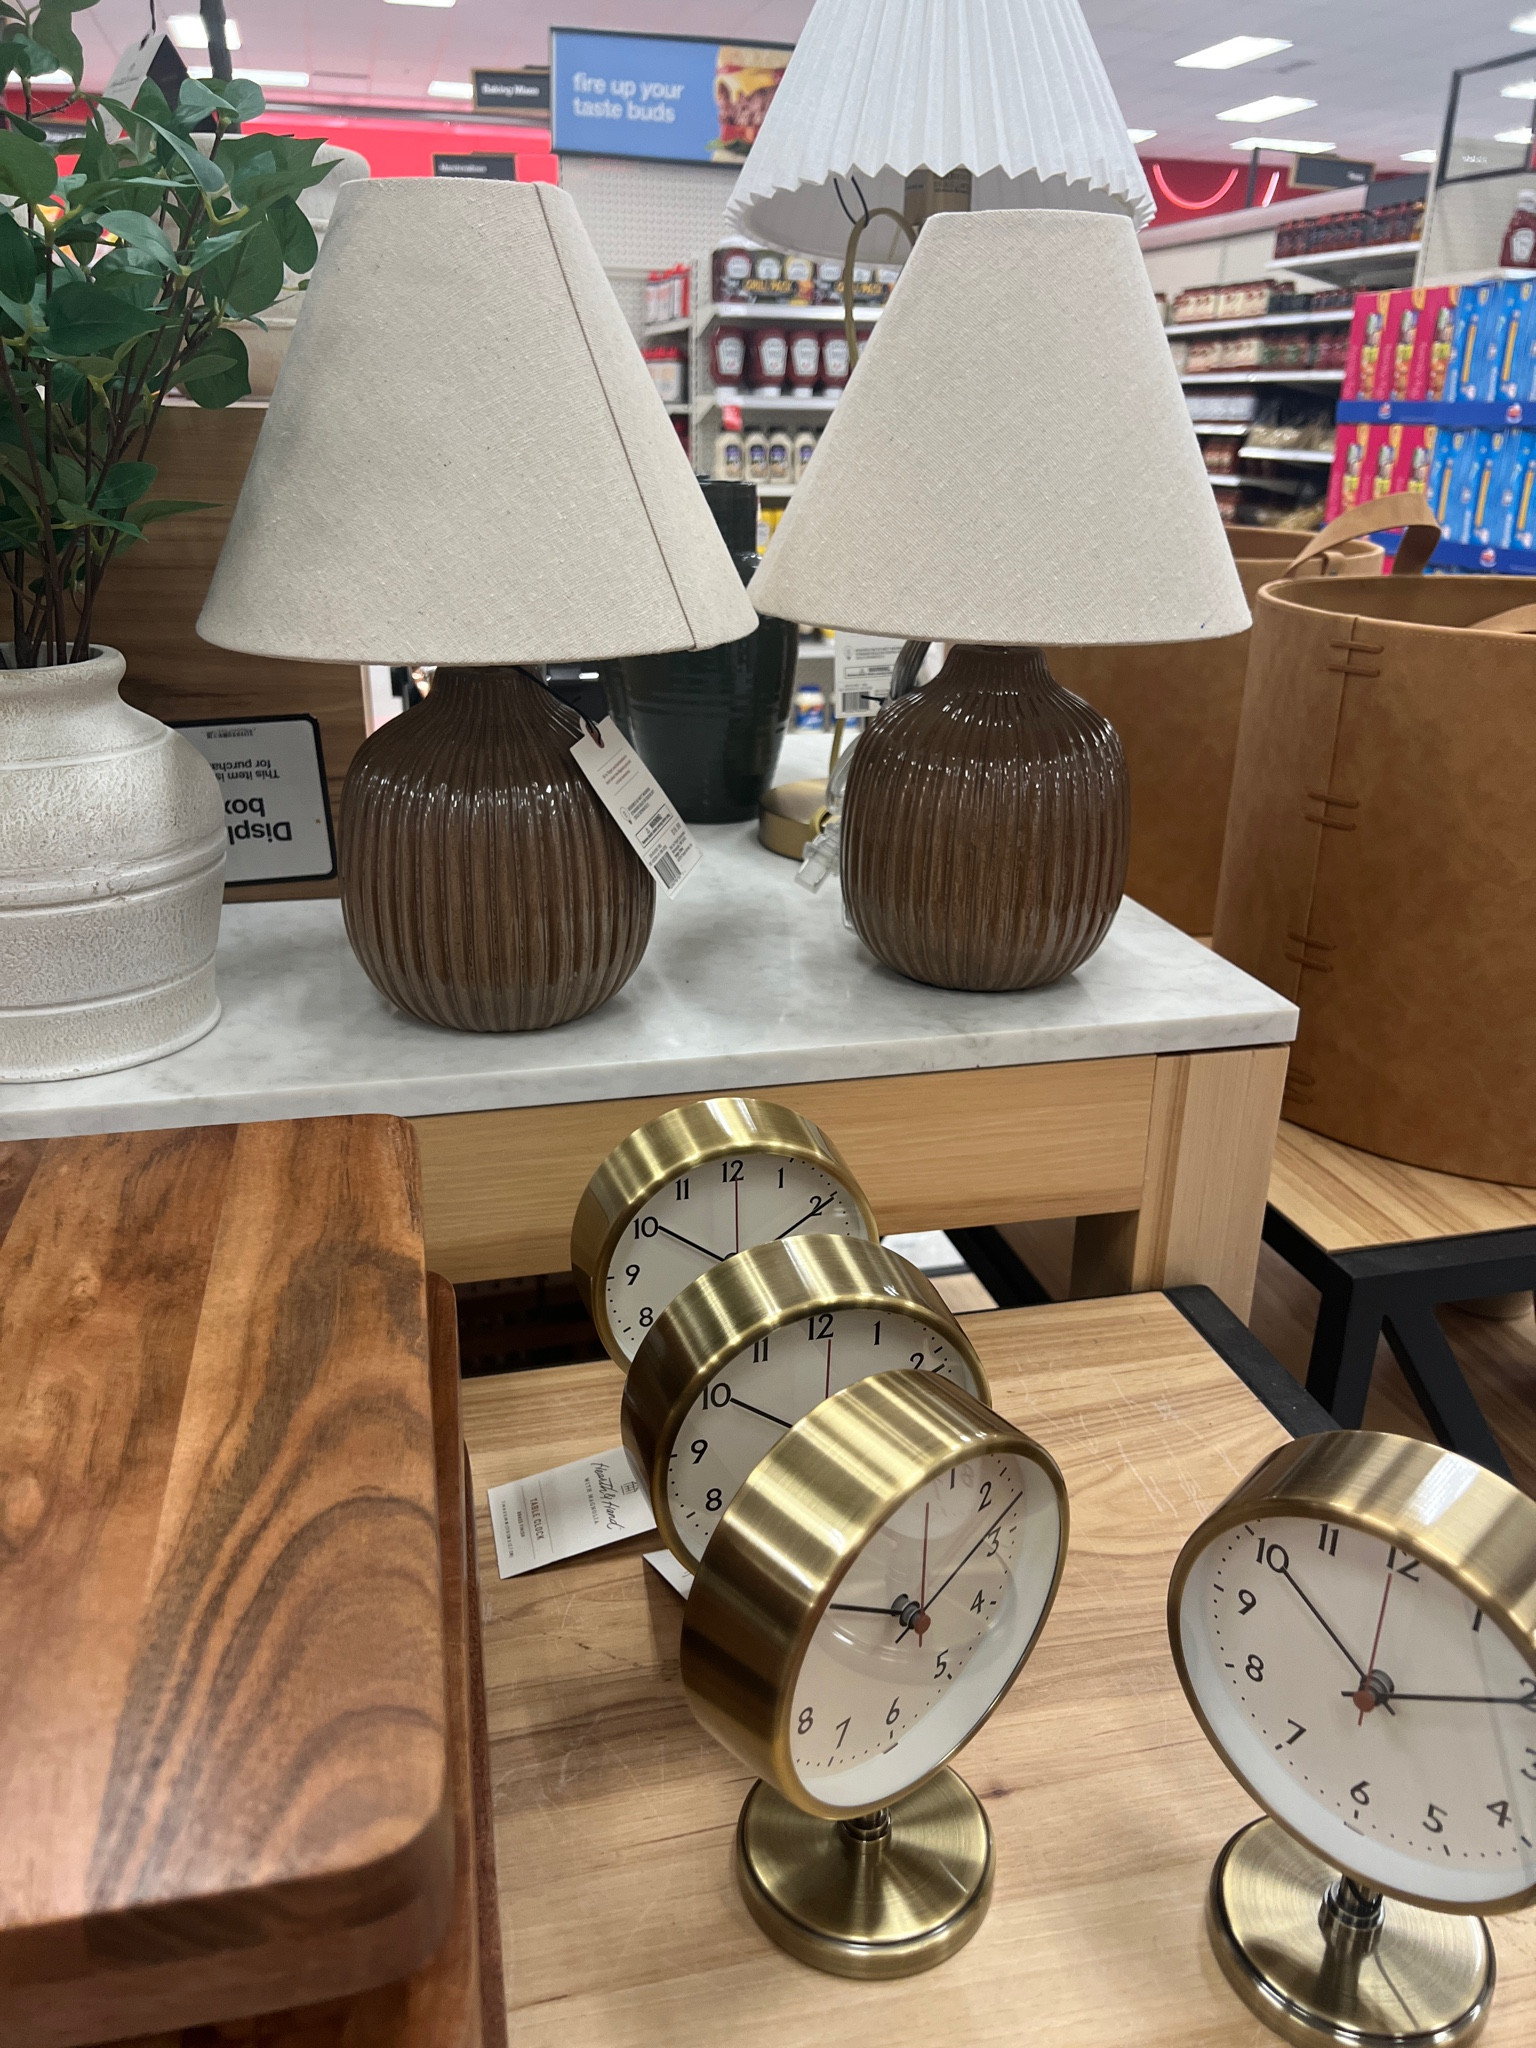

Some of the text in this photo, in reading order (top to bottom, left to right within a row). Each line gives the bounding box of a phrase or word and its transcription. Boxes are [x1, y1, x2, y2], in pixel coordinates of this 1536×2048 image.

[572, 72, 685, 101] fire up your
[573, 97, 676, 123] taste buds
[210, 759, 271, 770] for purcha
[227, 770, 253, 780] item
[256, 769, 280, 779] This
[228, 820, 292, 845] Displ
[722, 1160, 744, 1182] 12
[778, 1167, 784, 1189] 1
[676, 1178, 690, 1200] 11
[809, 1196, 823, 1216] 2
[634, 1216, 659, 1239] 10
[625, 1265, 640, 1286] 9
[639, 1307, 653, 1327] 8
[808, 1314, 834, 1340] 12
[874, 1321, 881, 1345] 1
[753, 1337, 769, 1363] 11
[702, 1383, 731, 1410] 10
[690, 1439, 709, 1464] 9
[591, 1462, 614, 1494] Hearth
[588, 1494, 600, 1525] MAGNOLIA
[705, 1488, 723, 1511] 8
[977, 1481, 992, 1513] 2
[530, 1498, 544, 1540] TABLE CLOCK
[601, 1499, 626, 1531] Hand
[986, 1527, 1001, 1557] 3
[1318, 1523, 1339, 1556] 11
[1256, 1537, 1289, 1573] 10
[970, 1589, 985, 1614] 4
[1238, 1589, 1257, 1615] 9
[933, 1649, 949, 1680] 5
[1245, 1654, 1264, 1682] 8
[797, 1706, 814, 1735] 8
[886, 1697, 900, 1726] 6
[836, 1717, 852, 1749] 7
[1286, 1719, 1306, 1745] 7
[1350, 1780, 1370, 1806] 6
[1422, 1803, 1448, 1833] 5
[1486, 1800, 1512, 1827] 4
